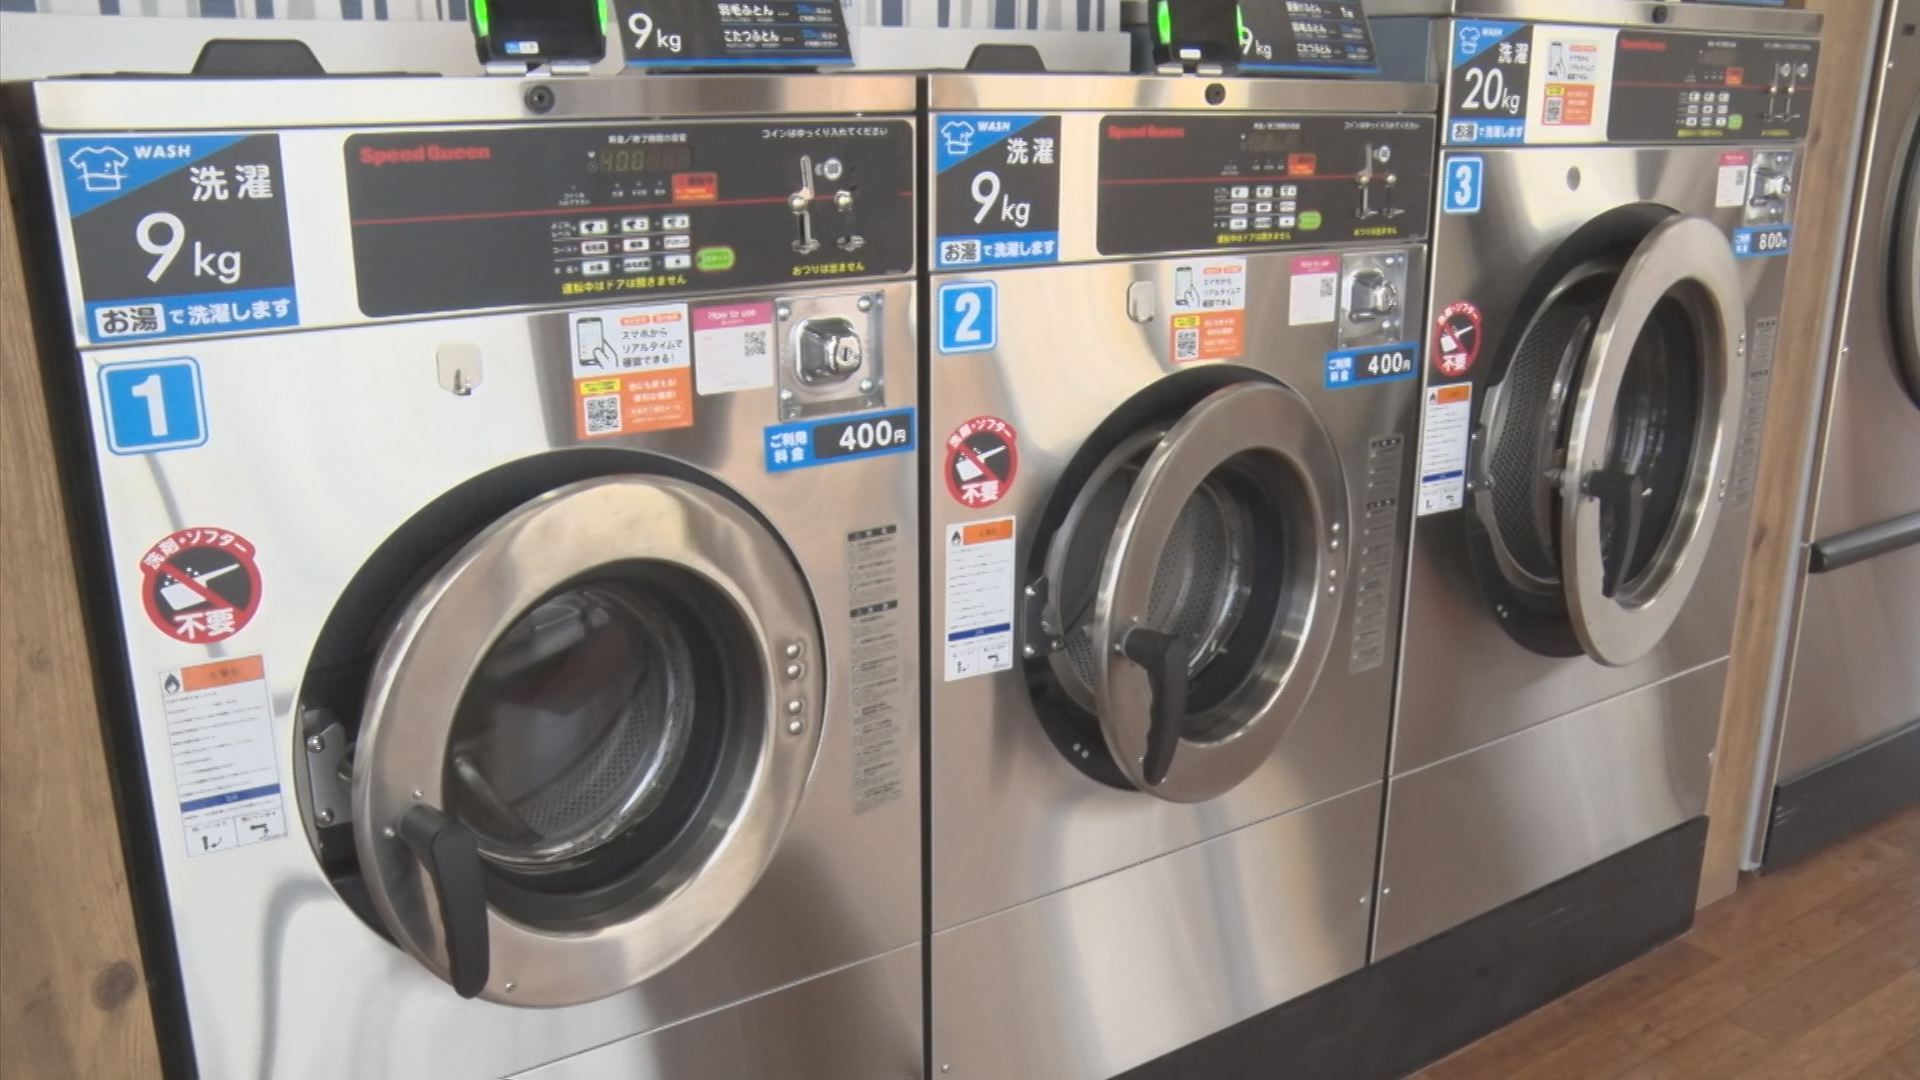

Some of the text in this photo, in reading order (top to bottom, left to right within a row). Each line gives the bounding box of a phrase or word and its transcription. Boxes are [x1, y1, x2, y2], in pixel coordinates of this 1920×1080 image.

[1461, 67, 1520, 114] 20kg
[762, 127, 888, 139] コインはゆっくり入れてください
[978, 121, 1010, 132] WASH
[134, 144, 191, 159] WASH
[360, 144, 490, 165] Speed Queen
[1006, 137, 1054, 165] 洗濯
[189, 164, 273, 201] 洗濯
[1454, 165, 1472, 206] 3
[971, 171, 1030, 228] 9kg
[136, 211, 240, 284] 9kg
[792, 262, 864, 275] おつりは出ません
[708, 308, 756, 321] How to use
[955, 291, 981, 342] 2
[622, 327, 668, 340] スマホから
[622, 339, 684, 354] リアルタイムで
[131, 374, 168, 437] 1
[771, 430, 807, 448] ご利用
[839, 420, 906, 449] 400円
[774, 448, 805, 464] 料金
[962, 481, 999, 503] 不要
[175, 608, 236, 639] 不要
